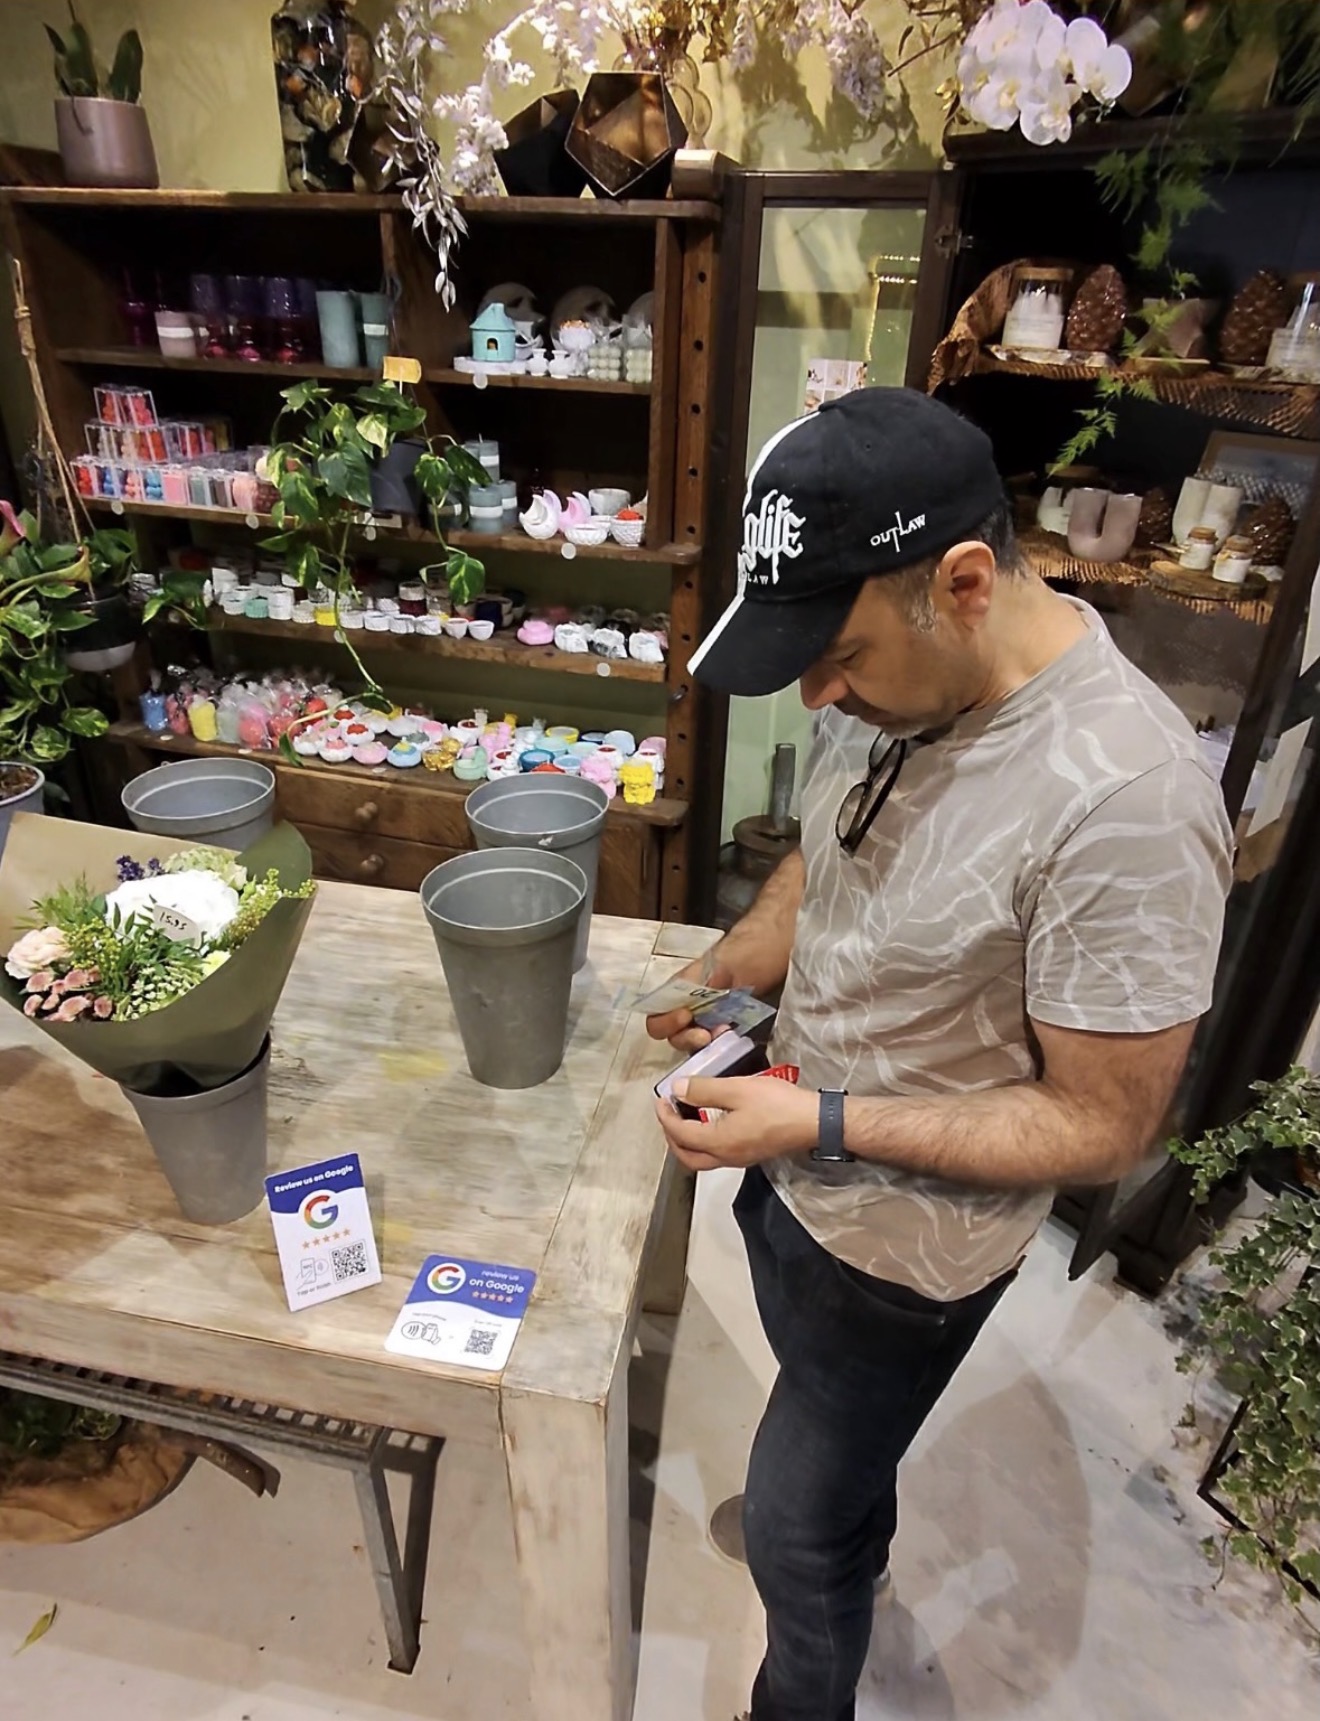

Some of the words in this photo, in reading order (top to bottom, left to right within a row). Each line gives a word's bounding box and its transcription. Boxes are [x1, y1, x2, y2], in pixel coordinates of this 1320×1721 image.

[870, 510, 926, 553] OUTLAW
[274, 1180, 303, 1193] Review
[314, 1174, 325, 1182] on
[325, 1165, 354, 1179] Google
[469, 1278, 484, 1287] on
[485, 1280, 525, 1294] Google
[481, 1270, 508, 1280] review
